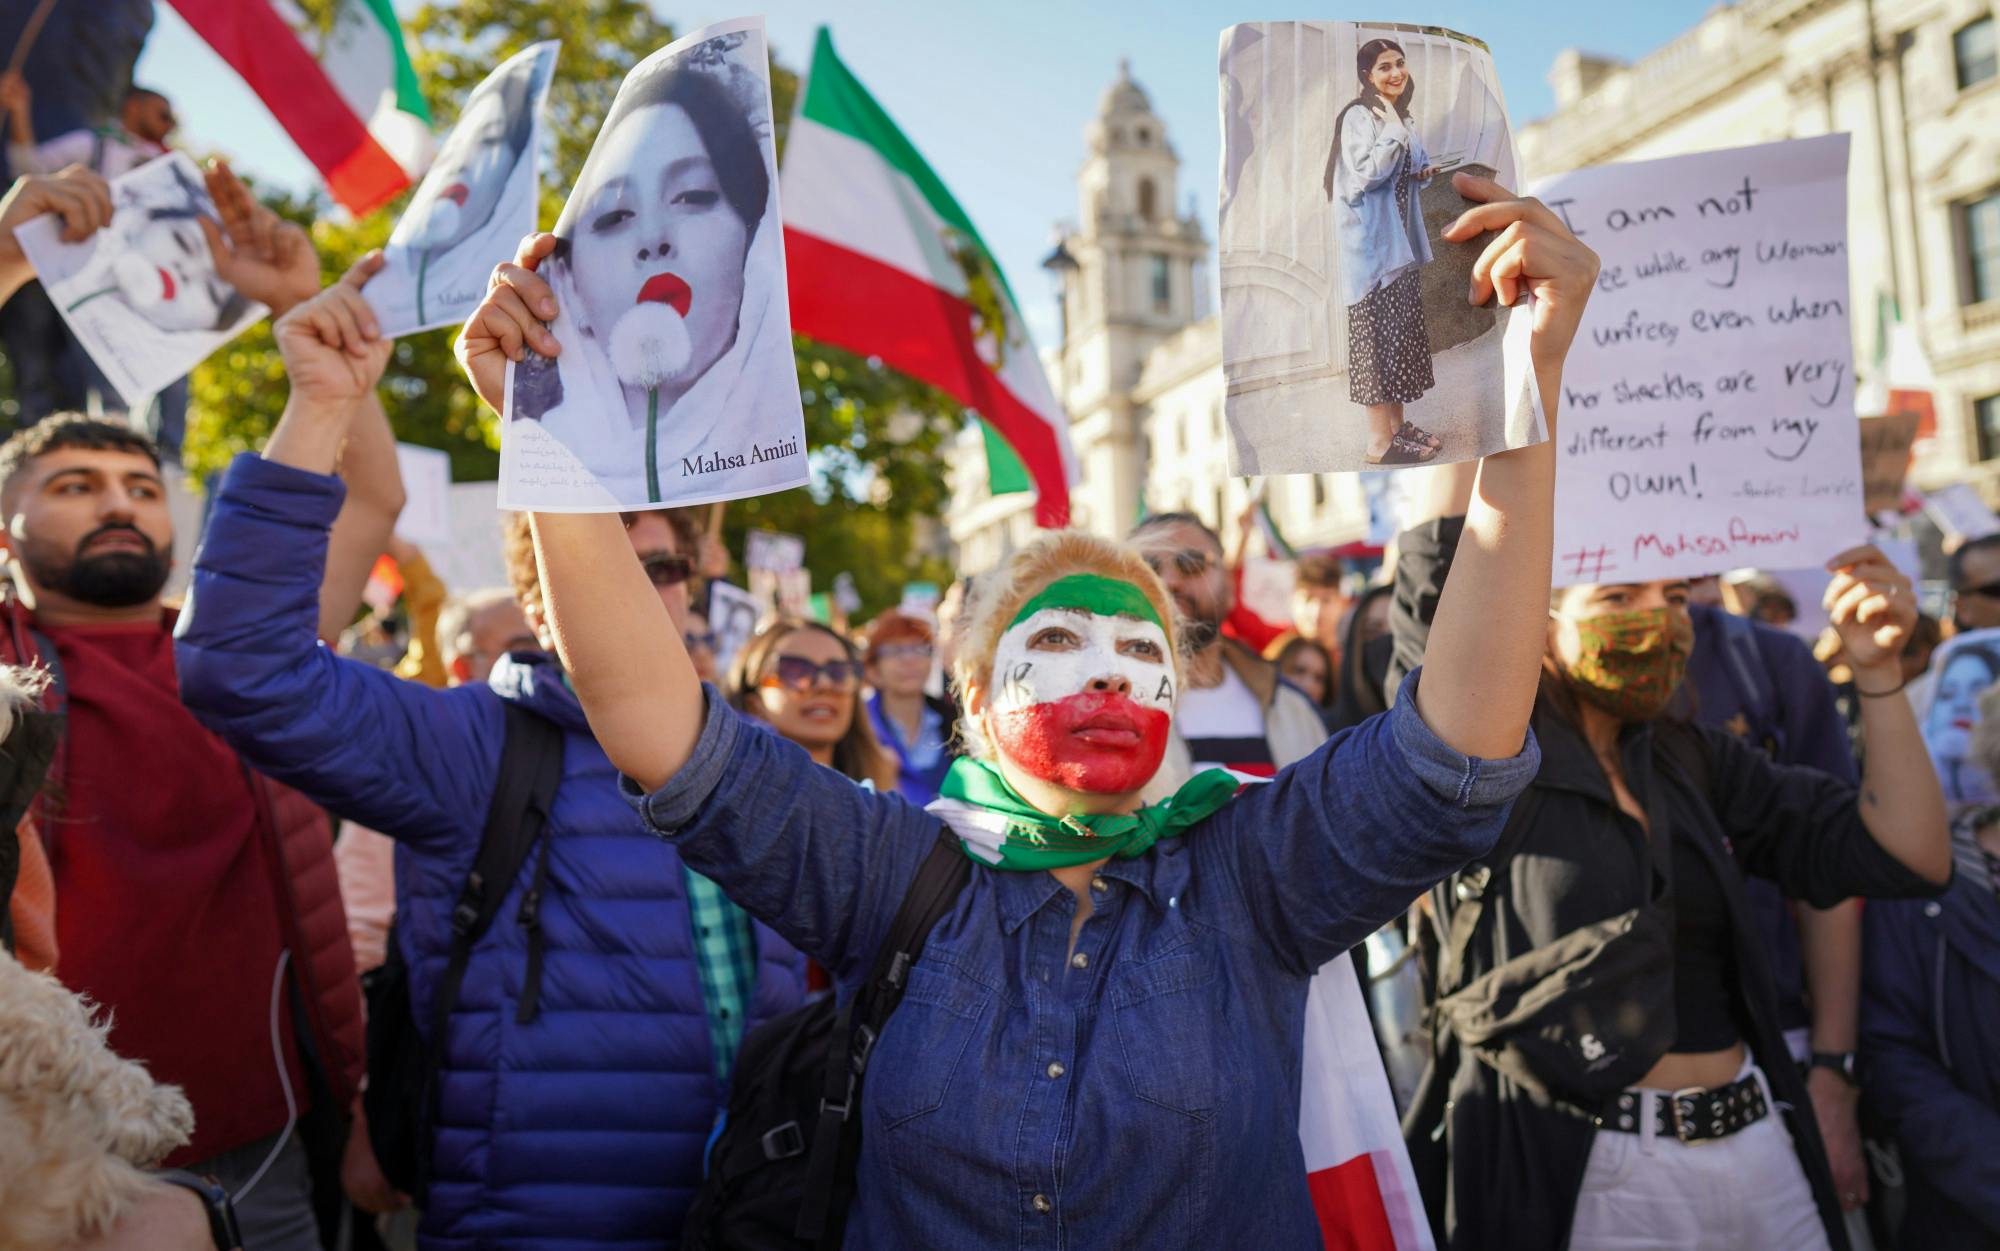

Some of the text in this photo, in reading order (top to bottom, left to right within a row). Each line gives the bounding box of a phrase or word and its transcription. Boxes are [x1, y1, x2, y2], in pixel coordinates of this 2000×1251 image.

[1549, 176, 1758, 237] I am not
[1635, 251, 1690, 280] while
[1701, 246, 1741, 289] any
[1691, 309, 1754, 333] even
[1716, 370, 1756, 393] are
[681, 435, 798, 476] Mahsa Amini
[1567, 411, 1819, 462] different from my
